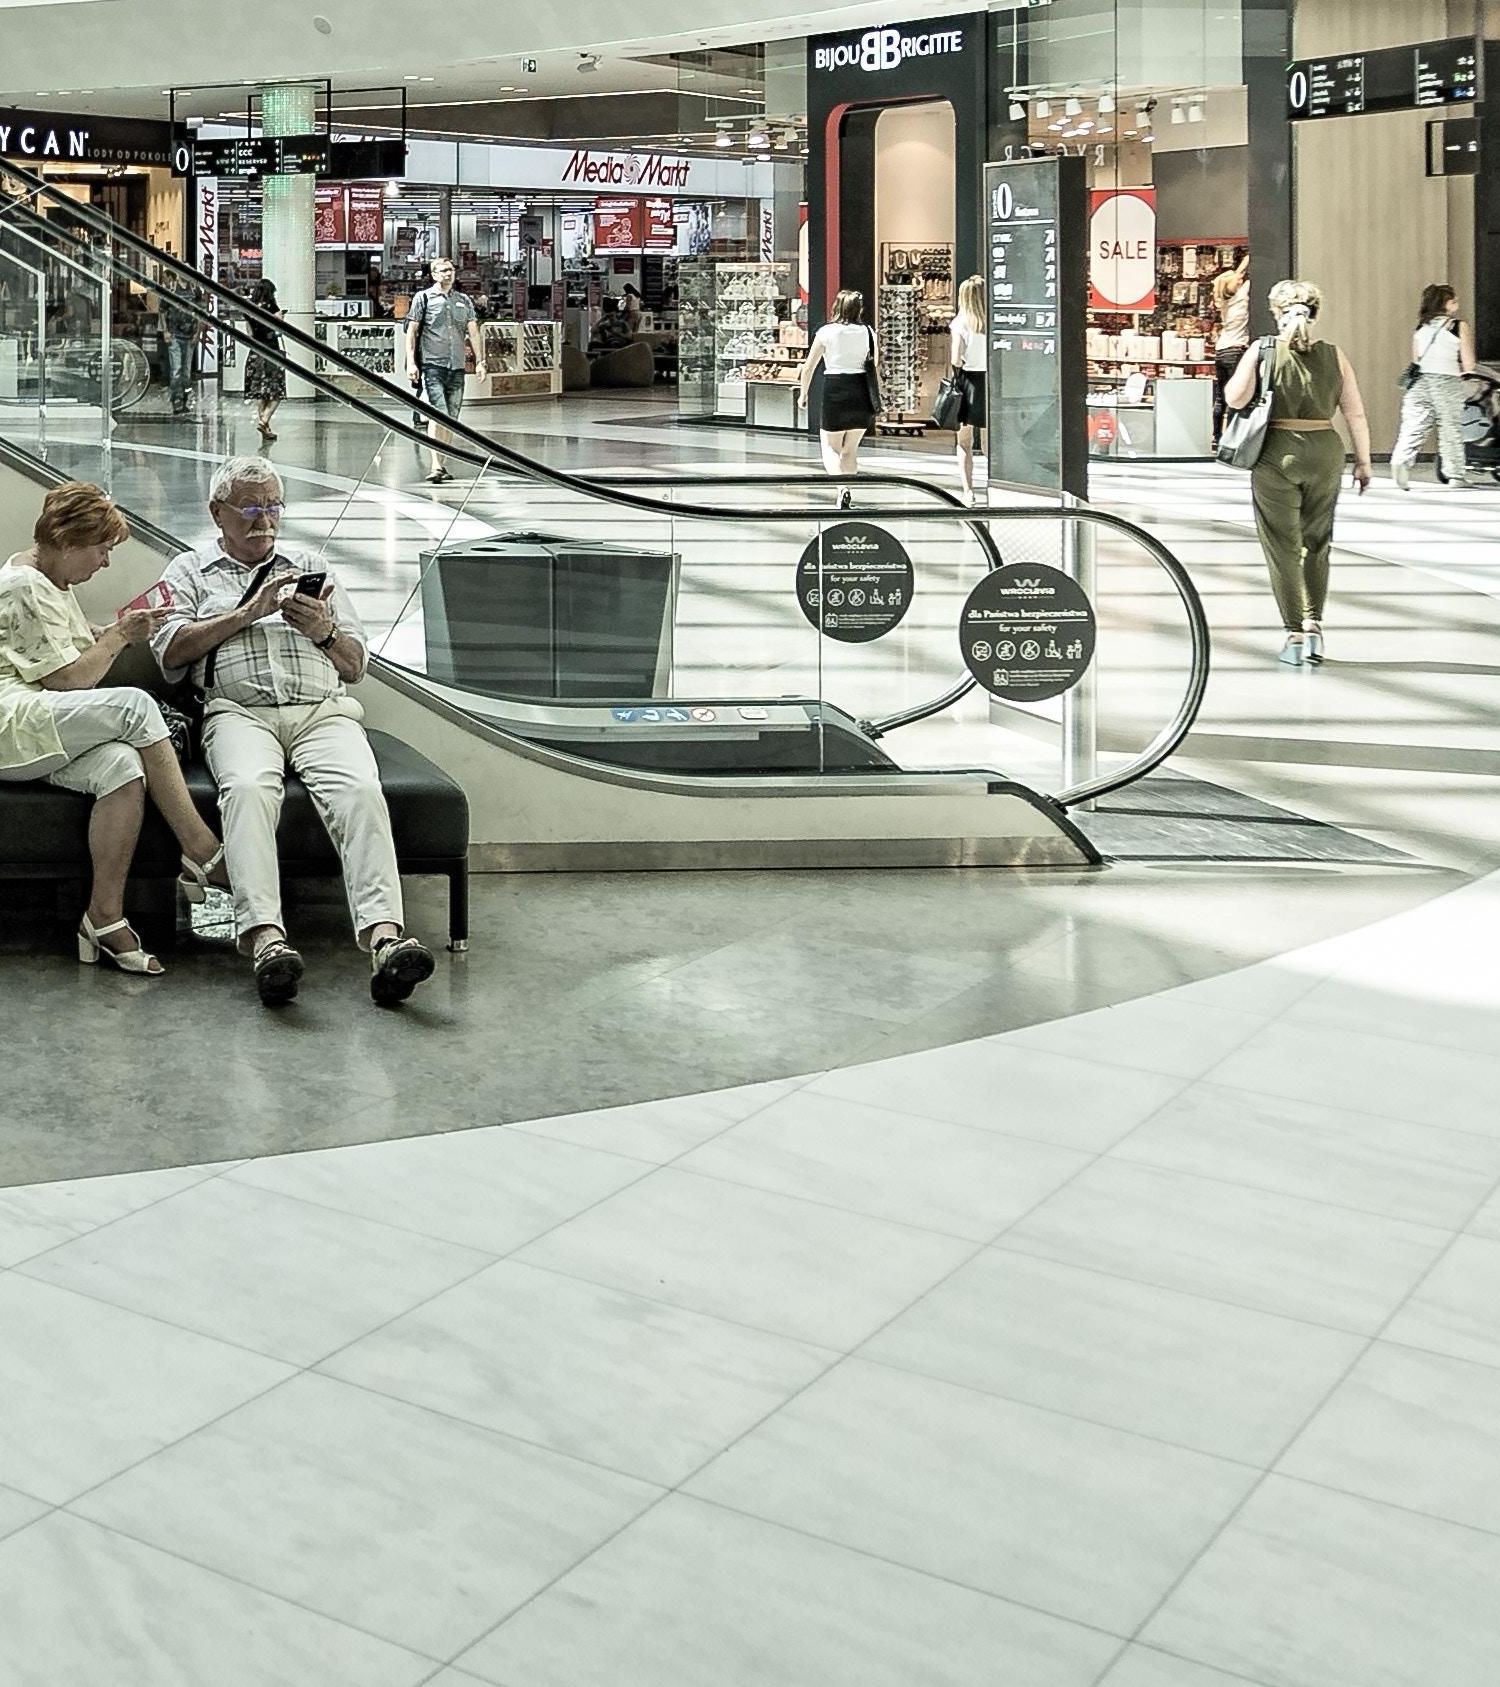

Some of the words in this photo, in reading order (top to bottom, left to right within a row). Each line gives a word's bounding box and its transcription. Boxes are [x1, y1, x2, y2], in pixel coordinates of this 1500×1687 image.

[815, 42, 861, 72] BIJOU
[1289, 71, 1307, 109] 0
[133, 149, 173, 162] POKOLE
[175, 147, 190, 172] 0
[562, 149, 624, 184] Media
[637, 153, 691, 187] Markt
[1098, 239, 1148, 262] SALE
